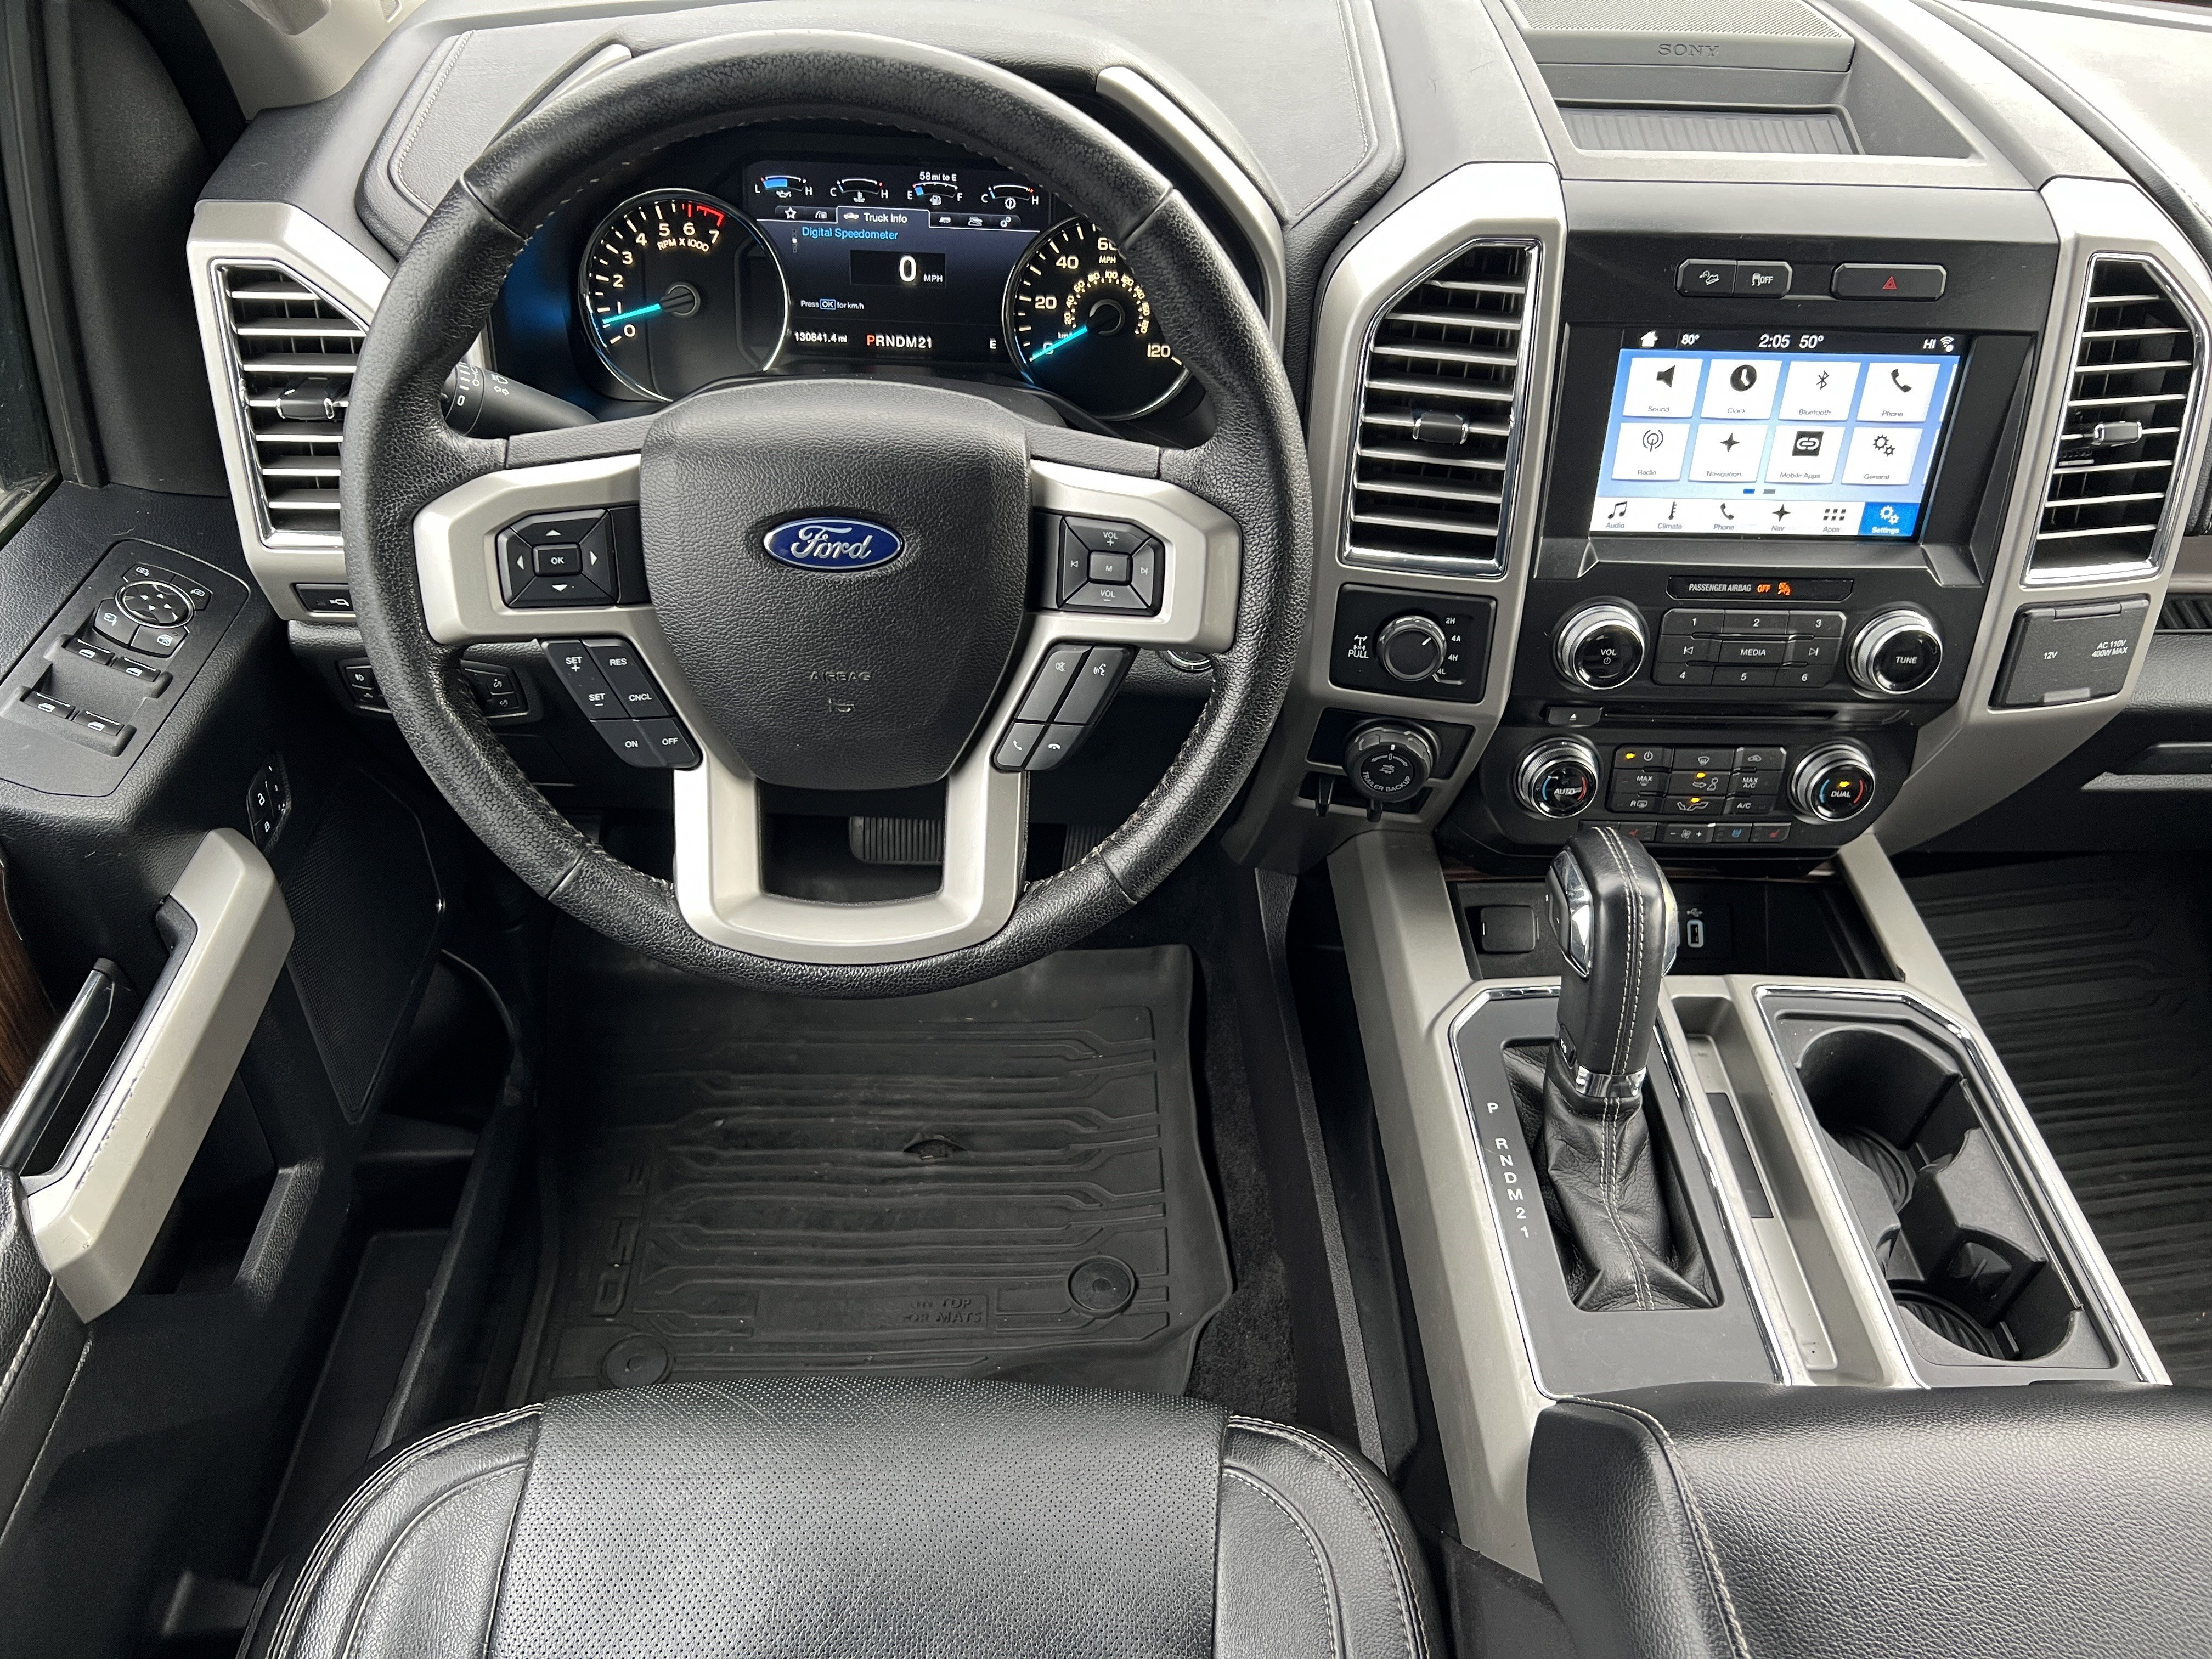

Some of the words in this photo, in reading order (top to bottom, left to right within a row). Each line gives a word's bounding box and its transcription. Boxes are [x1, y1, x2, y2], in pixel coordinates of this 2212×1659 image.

[1658, 43, 1720, 56] SONY
[919, 172, 931, 182] 58
[942, 173, 950, 182] to
[951, 173, 957, 182] E
[755, 185, 760, 194] L
[805, 187, 812, 195] H
[830, 188, 837, 197] C
[881, 190, 888, 199] H
[907, 191, 913, 200] E
[957, 193, 963, 202] F
[981, 194, 988, 204] C
[1032, 196, 1039, 205] H
[863, 212, 888, 223] Truck
[890, 214, 907, 224] Info
[659, 223, 670, 236] 5
[683, 222, 695, 236] 6
[802, 226, 832, 238] Digital
[834, 228, 898, 241] Speedometer
[635, 233, 647, 246] 4
[709, 230, 720, 244] 7
[657, 238, 676, 250] RPM
[687, 238, 709, 252] 1000
[622, 251, 633, 264] 3
[1099, 255, 1116, 264] MPH
[1056, 256, 1079, 270] 40
[899, 254, 917, 283] 0
[924, 273, 944, 284] MPH
[1104, 270, 1119, 279] 100
[613, 275, 624, 287] 2
[1760, 275, 1774, 285] OFF
[1073, 280, 1086, 293] 60
[800, 300, 820, 309] Press
[822, 301, 835, 309] OK
[837, 301, 847, 309] for
[847, 301, 865, 311] km/h
[1035, 296, 1057, 310] 20
[1066, 295, 1075, 308] 40
[617, 301, 622, 314] 1
[1063, 312, 1072, 325] 20
[623, 324, 636, 337] 0
[794, 331, 837, 344] 130841.4
[1681, 334, 1700, 346] 80°
[1759, 334, 1791, 348] 2:05
[1799, 335, 1824, 349] 50°
[990, 339, 997, 349] E
[1923, 338, 1936, 349] HI
[1147, 343, 1171, 358] 120
[1798, 408, 1831, 416] Bluetooth
[1882, 410, 1904, 418] Phone
[1803, 472, 1821, 481] Apps
[1822, 525, 1841, 534] Apps
[1871, 526, 1899, 535] Settings
[1103, 531, 1119, 540] VOL
[790, 525, 874, 560] Ford
[550, 556, 565, 565] OK
[1689, 583, 1726, 593] PASSENGER
[1727, 584, 1752, 593] AIRBAG
[1757, 584, 1771, 593] OFF
[1101, 589, 1116, 598] VOL
[1691, 618, 1697, 627] 1
[1753, 618, 1760, 628] 2
[1815, 619, 1822, 628] 3
[2097, 641, 2108, 650] AC
[2110, 639, 2128, 648] 110V
[1348, 649, 1369, 659] PULL
[1740, 648, 1767, 657] MEDIA
[2044, 651, 2058, 659] 12V
[2091, 649, 2112, 658] 400W
[2111, 646, 2128, 656] MAX
[566, 656, 582, 664] SET
[609, 658, 627, 666] RES
[1895, 656, 1918, 664] TUNE
[809, 671, 872, 682] AIRBAG
[1679, 672, 1686, 681] 4
[1740, 672, 1747, 681] 5
[1801, 673, 1808, 682] 6
[588, 693, 606, 701] SET
[662, 737, 678, 746] OFF
[1362, 771, 1384, 792] TRAILER
[1385, 775, 1412, 792] BACKUP
[1637, 775, 1653, 783] MAX
[1554, 787, 1576, 795] AUTO
[1830, 790, 1852, 798] DUAL
[1487, 1102, 1499, 1114] P
[1495, 1138, 1508, 1149] R
[1499, 1155, 1513, 1166] N
[1504, 1172, 1517, 1184] D
[1507, 1188, 1523, 1200] M
[1515, 1207, 1527, 1219] 2
[1520, 1226, 1530, 1238] 1
[935, 1311, 983, 1323] MATS
